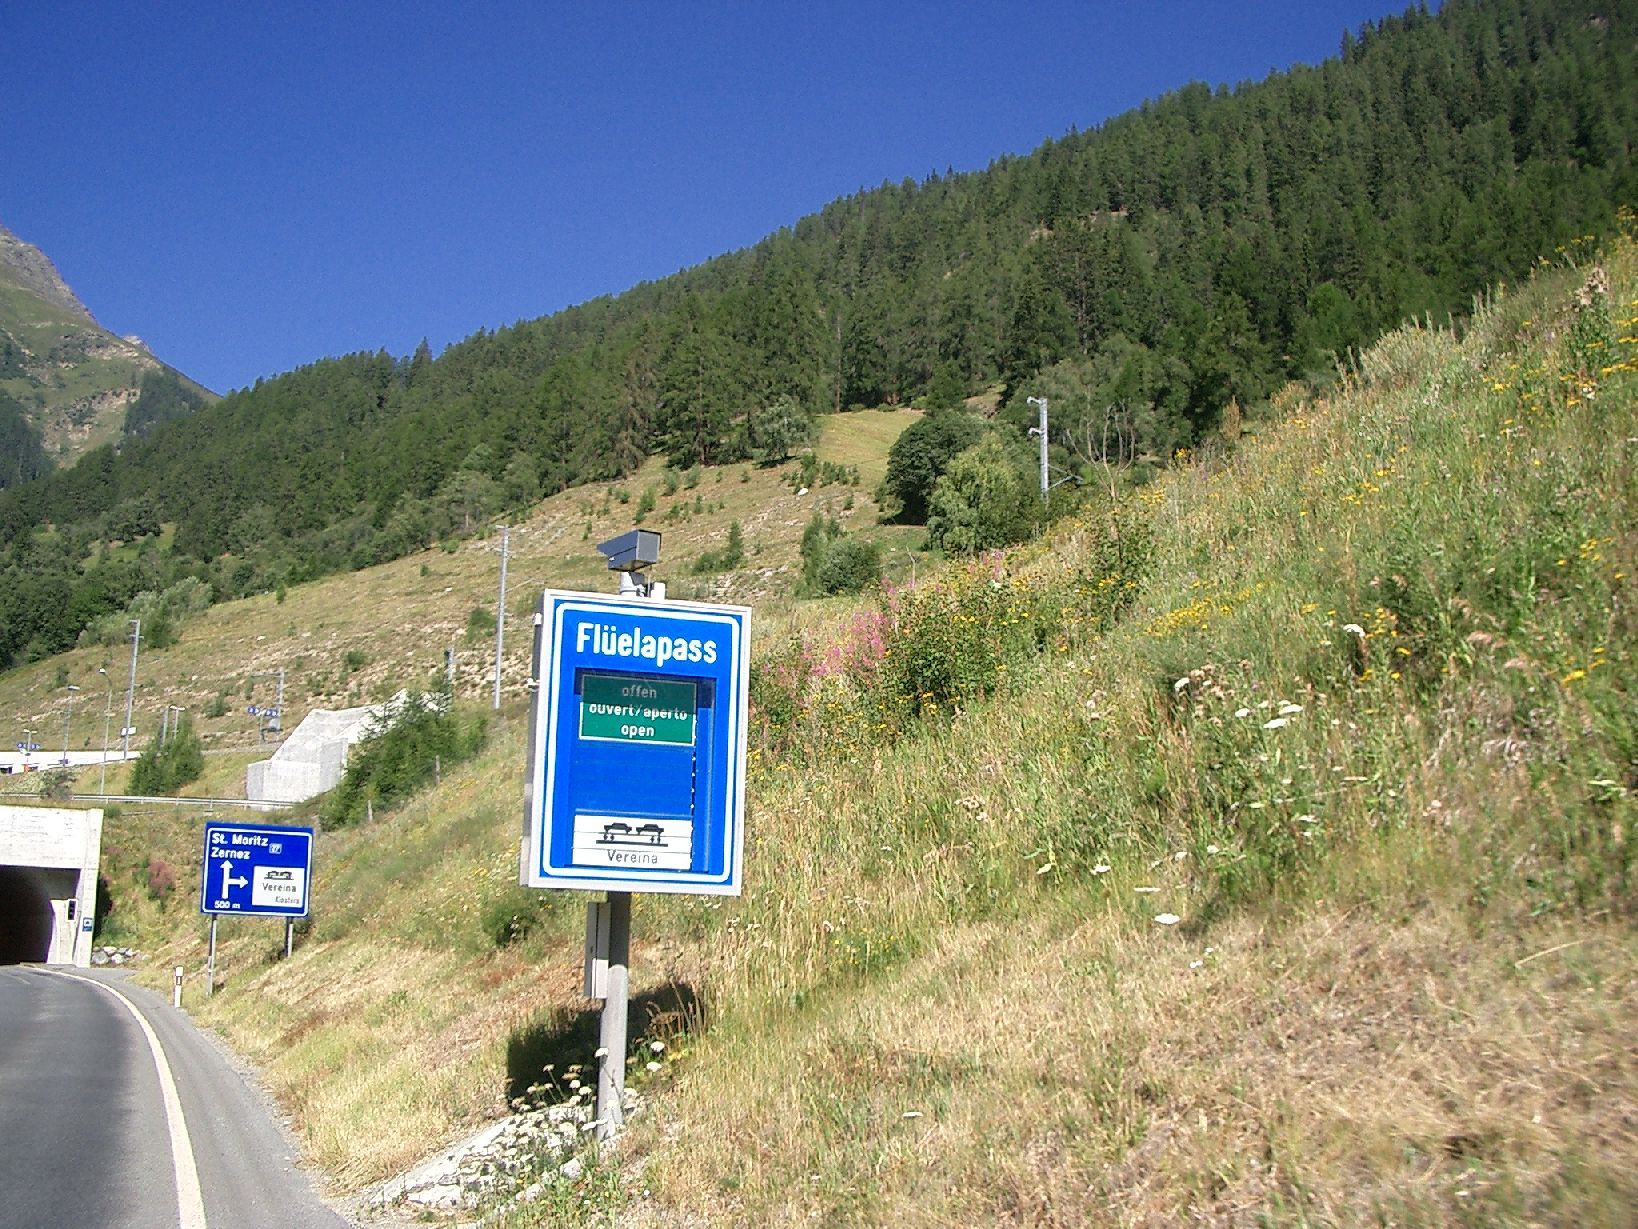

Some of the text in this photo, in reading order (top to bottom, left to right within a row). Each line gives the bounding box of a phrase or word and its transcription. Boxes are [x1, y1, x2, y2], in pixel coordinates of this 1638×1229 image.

[576, 621, 718, 667] Flüelapass
[622, 683, 657, 698] offen
[589, 703, 687, 720] ouvert/aperto
[620, 724, 655, 738] open
[212, 832, 268, 846] St. Moritz
[211, 847, 250, 859] Zernez
[607, 848, 659, 865] Vereina
[262, 882, 297, 893] Vereina
